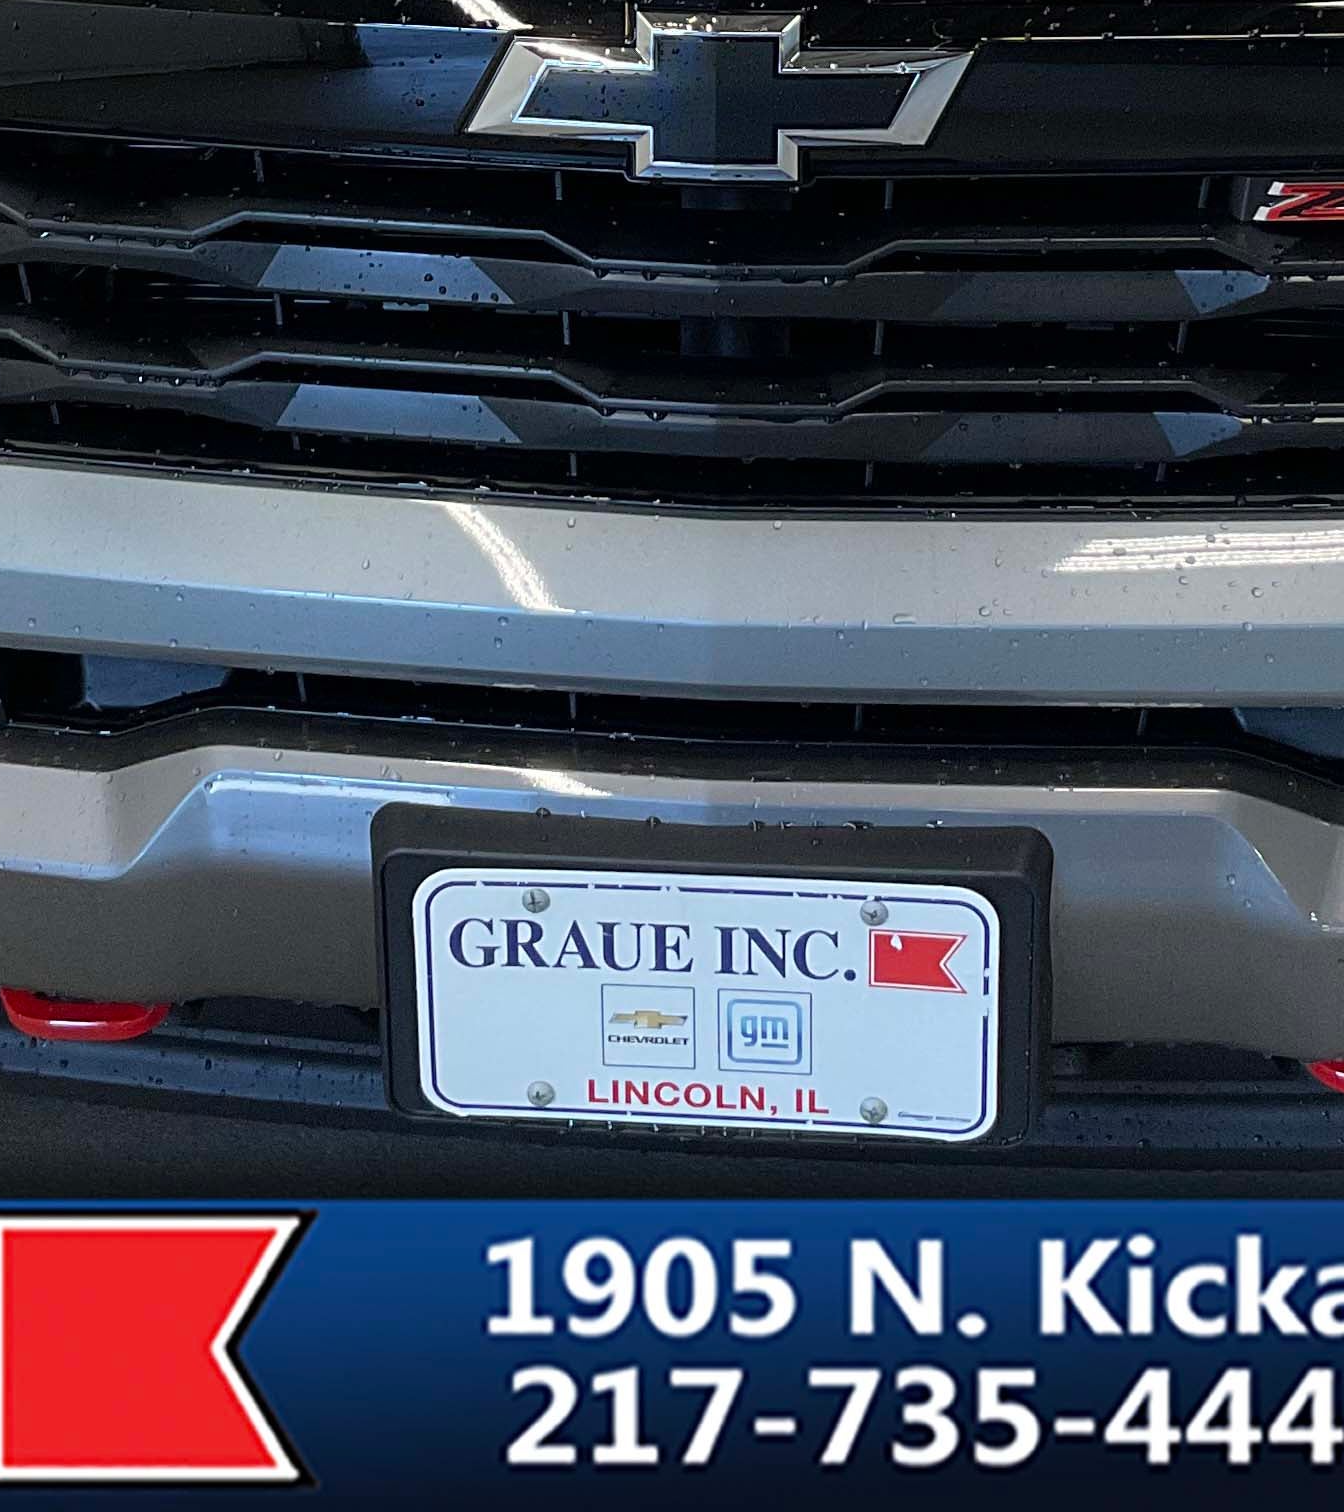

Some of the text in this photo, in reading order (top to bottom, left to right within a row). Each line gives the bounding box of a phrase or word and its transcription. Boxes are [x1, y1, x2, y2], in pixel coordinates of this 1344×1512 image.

[448, 917, 857, 982] GRAUE INC.
[607, 1034, 689, 1046] CHEVROLET
[740, 1015, 789, 1049] gm
[588, 1079, 830, 1116] LINCOLN, IL
